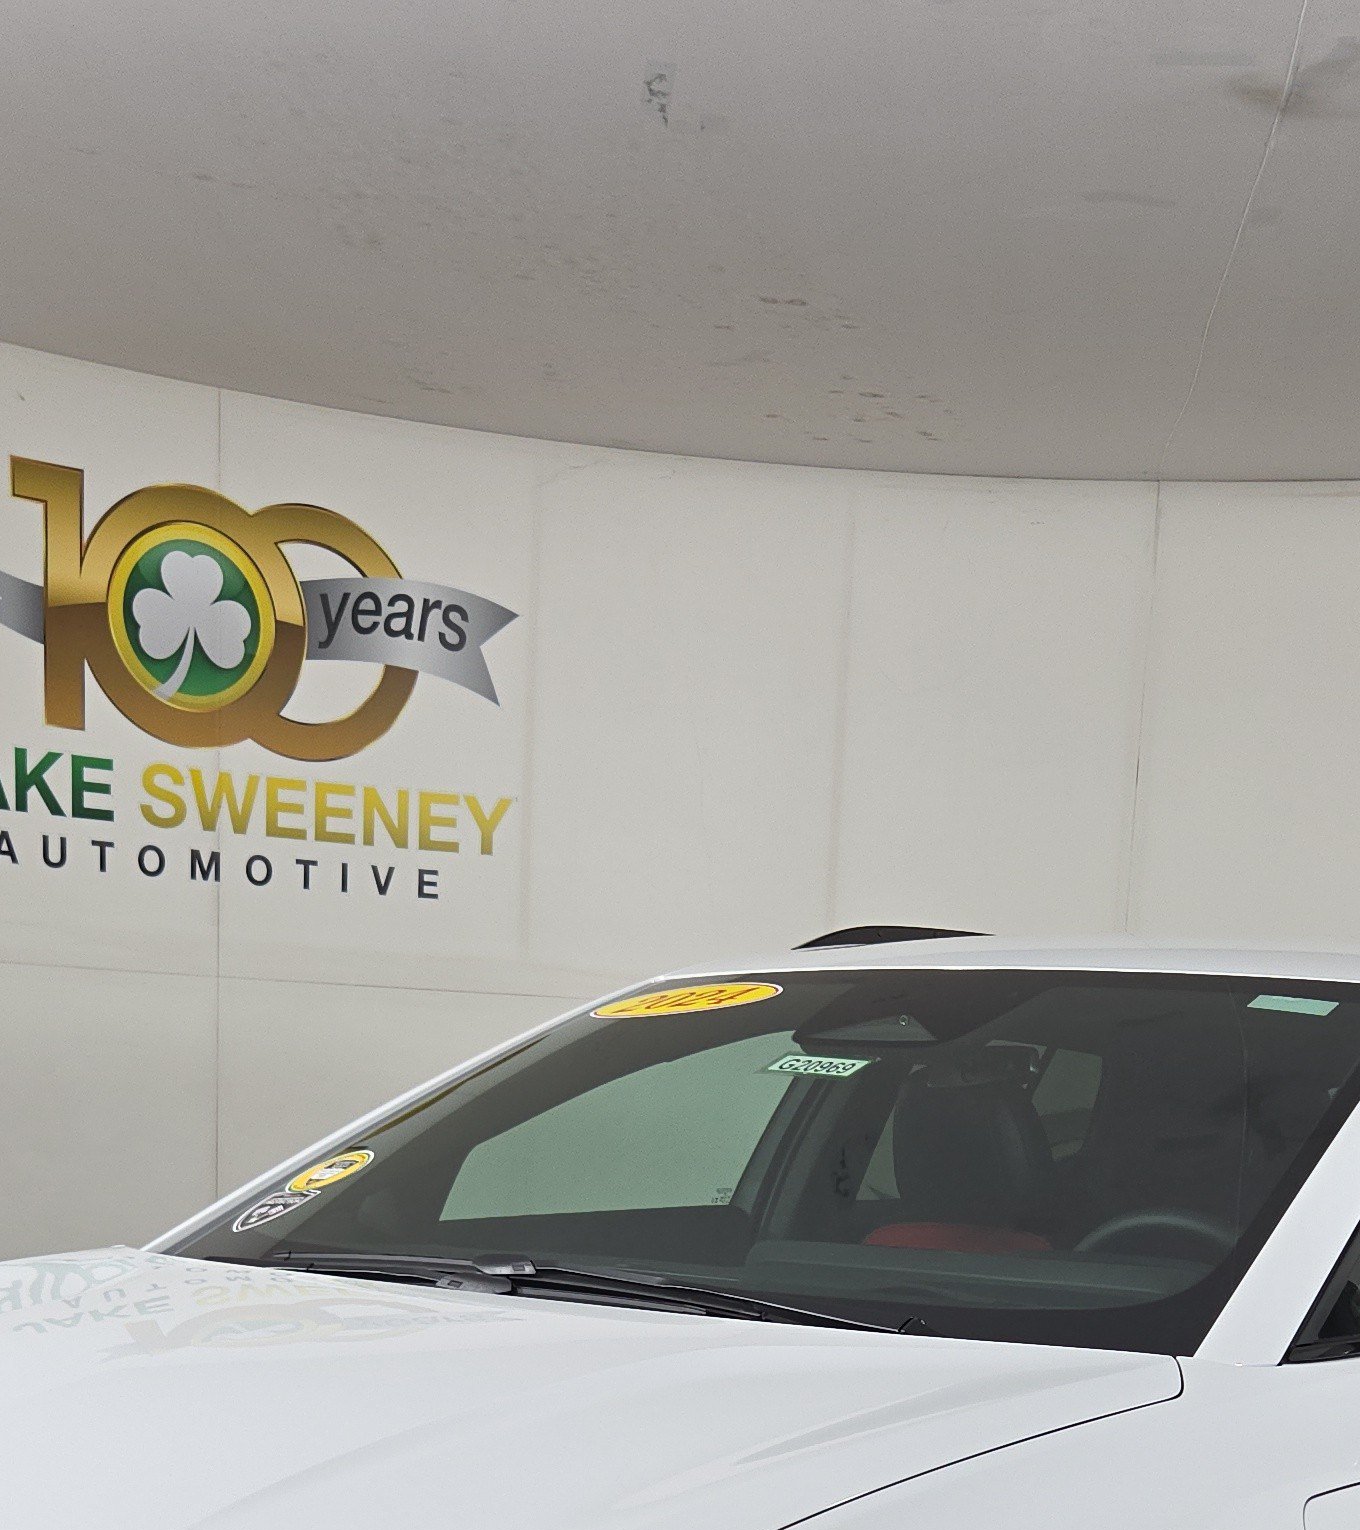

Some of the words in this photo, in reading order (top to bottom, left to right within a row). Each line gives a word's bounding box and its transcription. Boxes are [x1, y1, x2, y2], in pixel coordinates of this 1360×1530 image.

[317, 589, 471, 653] years
[140, 762, 513, 857] SWEENEY
[611, 986, 760, 1014] 2024
[778, 1058, 857, 1075] G20969
